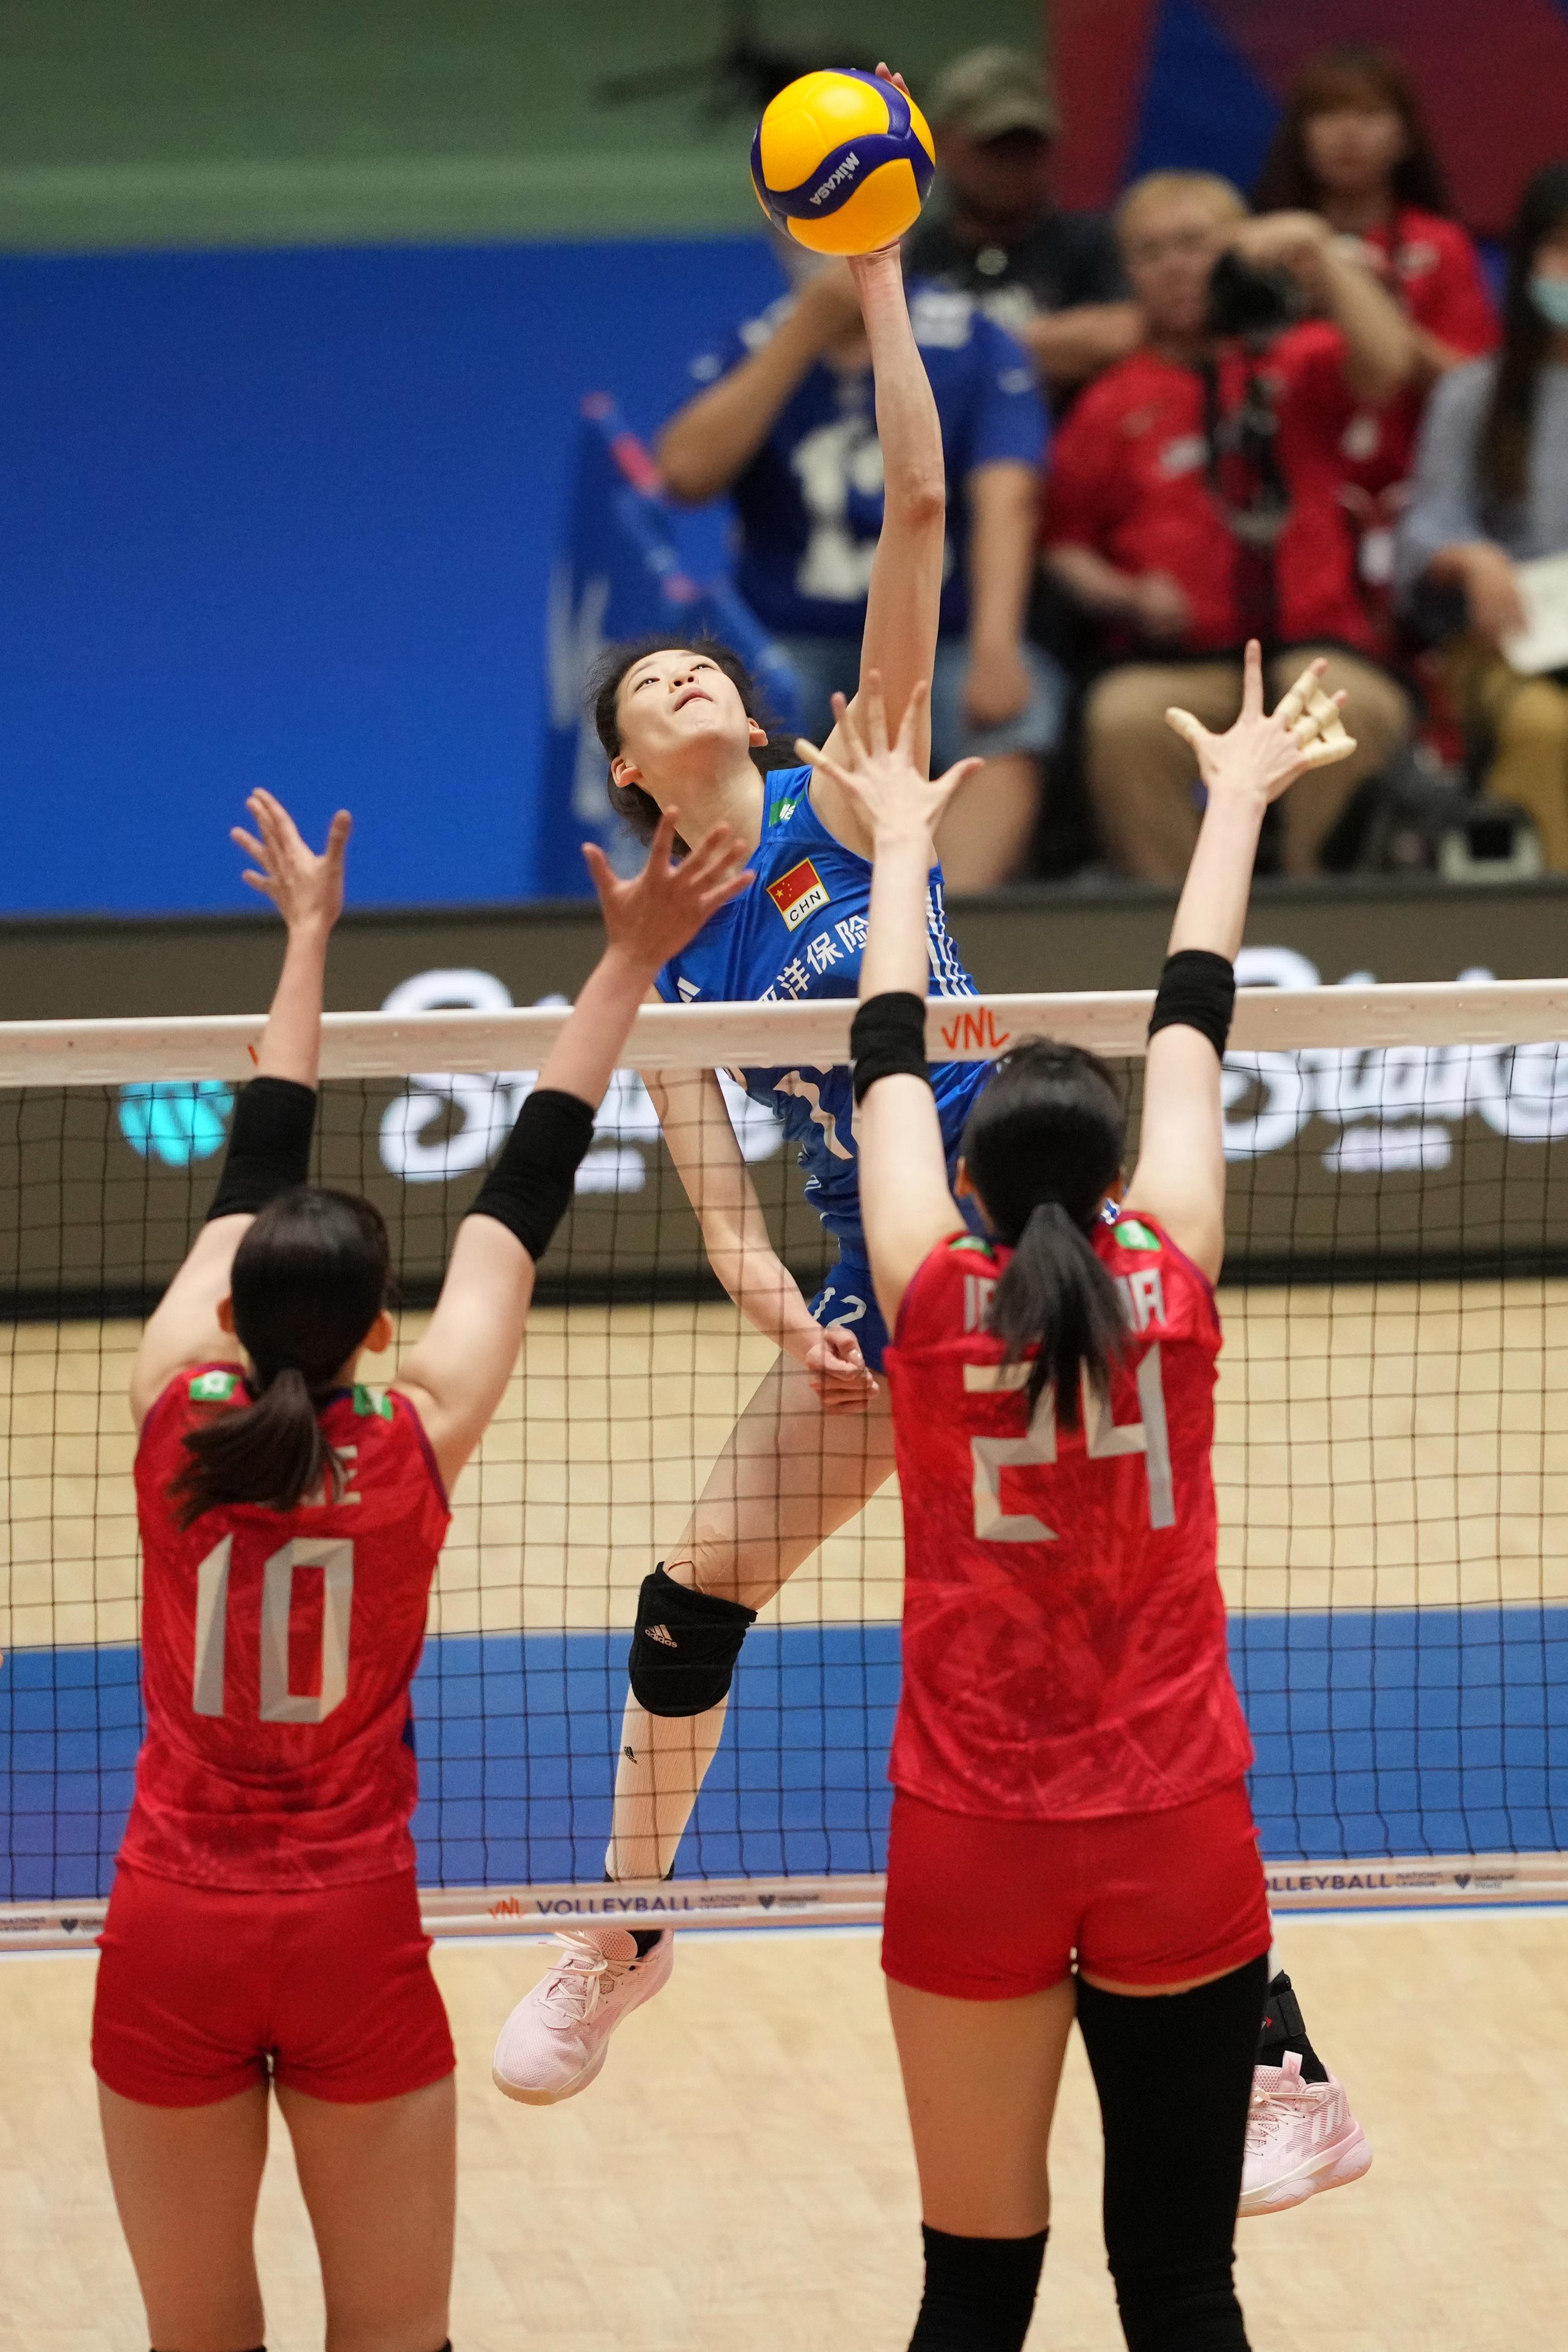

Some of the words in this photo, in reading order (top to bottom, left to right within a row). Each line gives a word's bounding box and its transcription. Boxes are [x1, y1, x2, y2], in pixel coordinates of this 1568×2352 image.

[790, 891, 822, 922] CHN
[941, 1006, 1010, 1050] VNL
[963, 1341, 1176, 1543] 24
[193, 1532, 354, 1724] 10
[645, 1629, 678, 1648] adidas
[536, 1895, 695, 1916] VOLLEYBALL
